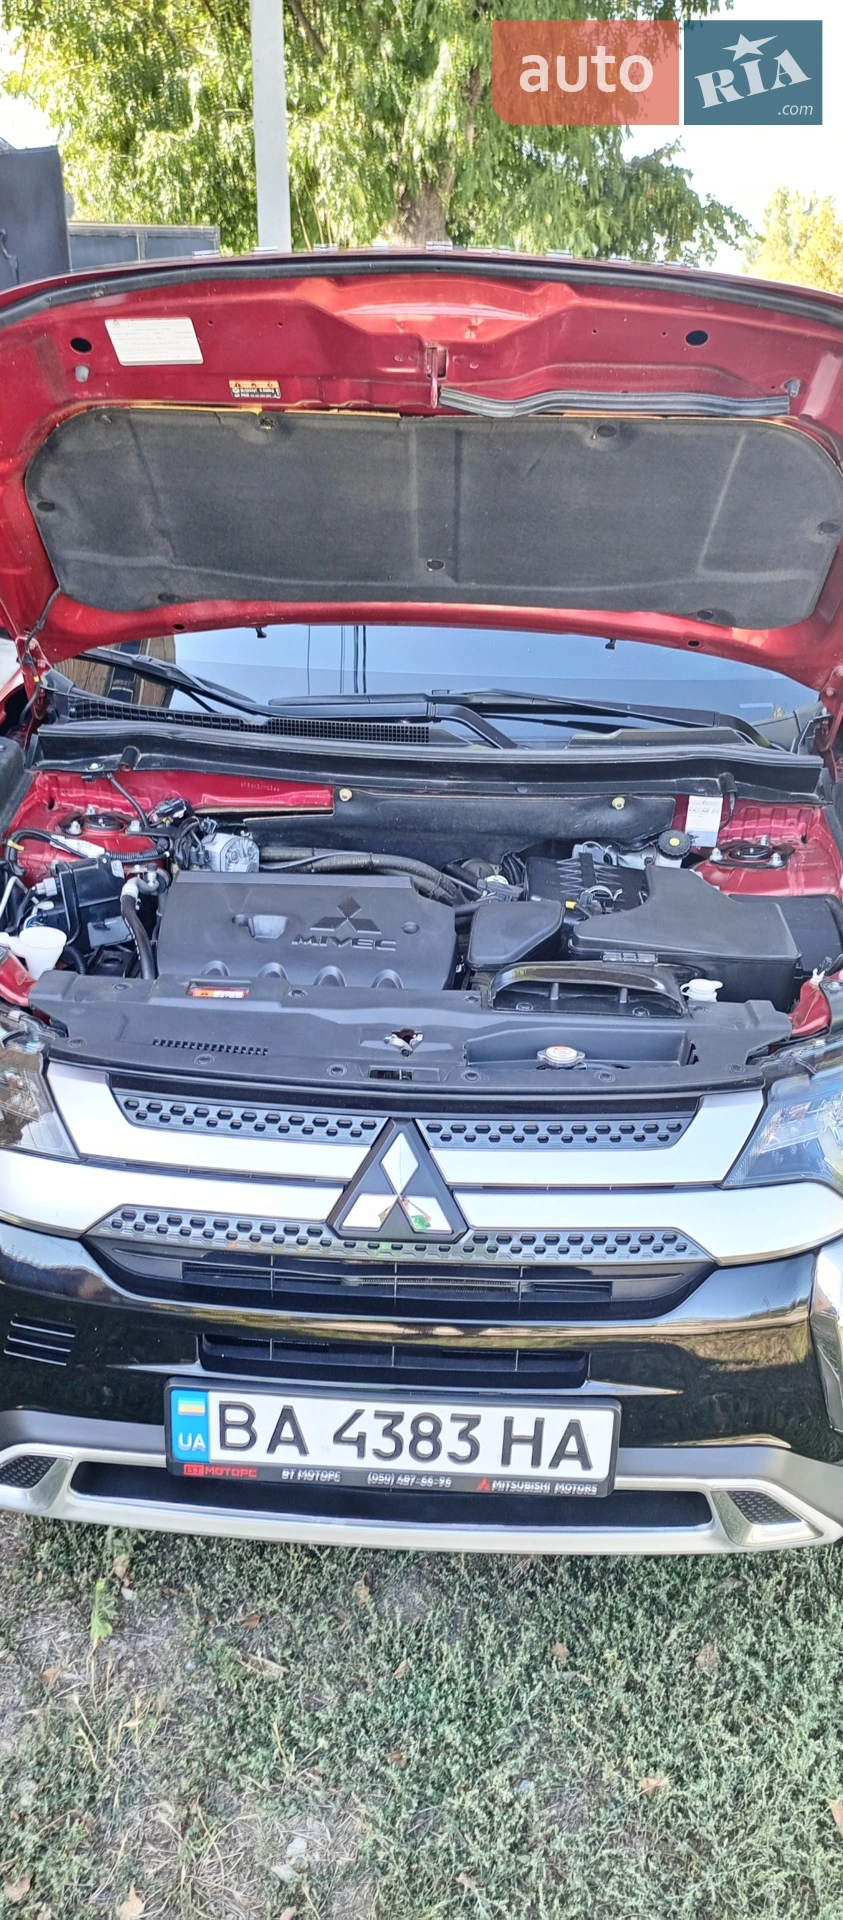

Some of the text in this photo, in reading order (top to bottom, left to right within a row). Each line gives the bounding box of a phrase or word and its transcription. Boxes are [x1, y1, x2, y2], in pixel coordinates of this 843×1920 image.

[291, 934, 397, 951] MIVEC
[177, 1432, 207, 1452] UA
[218, 1400, 594, 1471] BA 4383 HA
[492, 1480, 598, 1495] MITSUBISHI MOTORS
